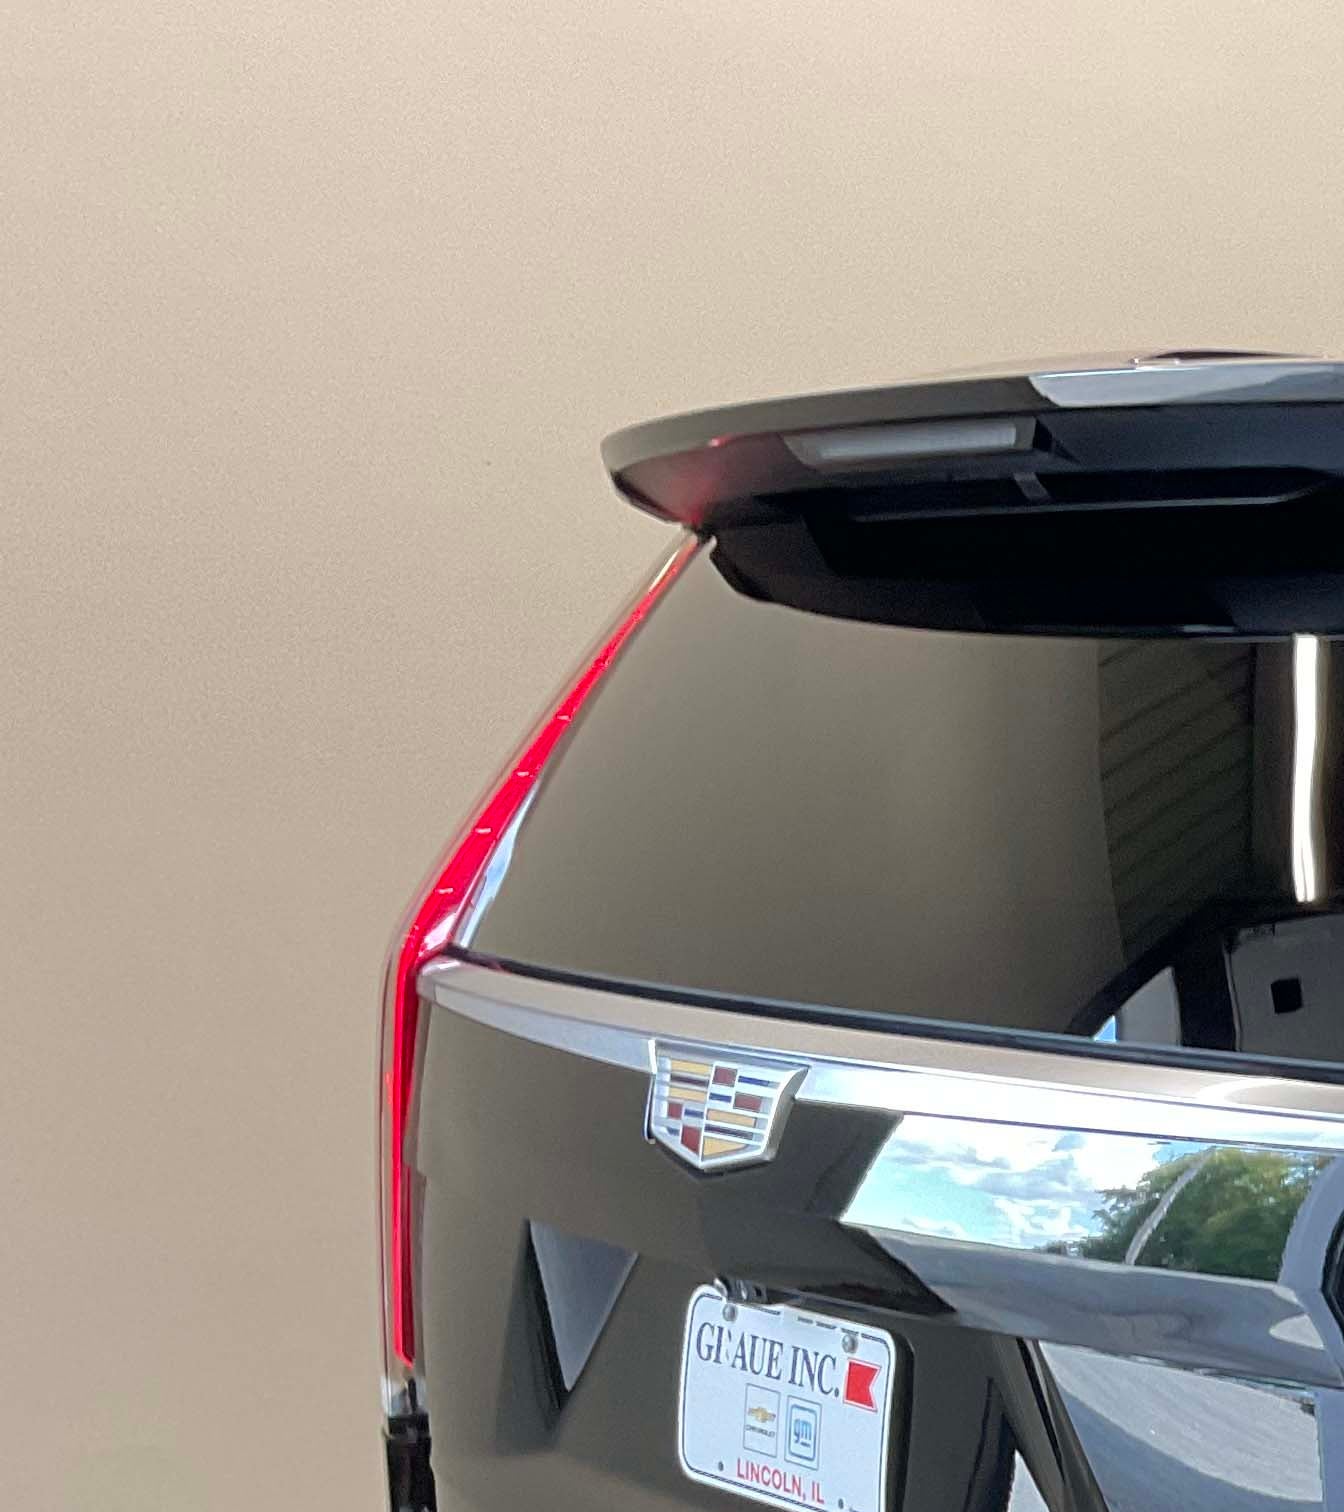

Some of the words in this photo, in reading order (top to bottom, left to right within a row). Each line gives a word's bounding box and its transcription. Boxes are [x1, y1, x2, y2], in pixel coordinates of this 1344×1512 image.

[788, 1345, 840, 1398] INC.
[736, 1457, 806, 1502] LINCOLN,
[811, 1480, 825, 1505] IL
